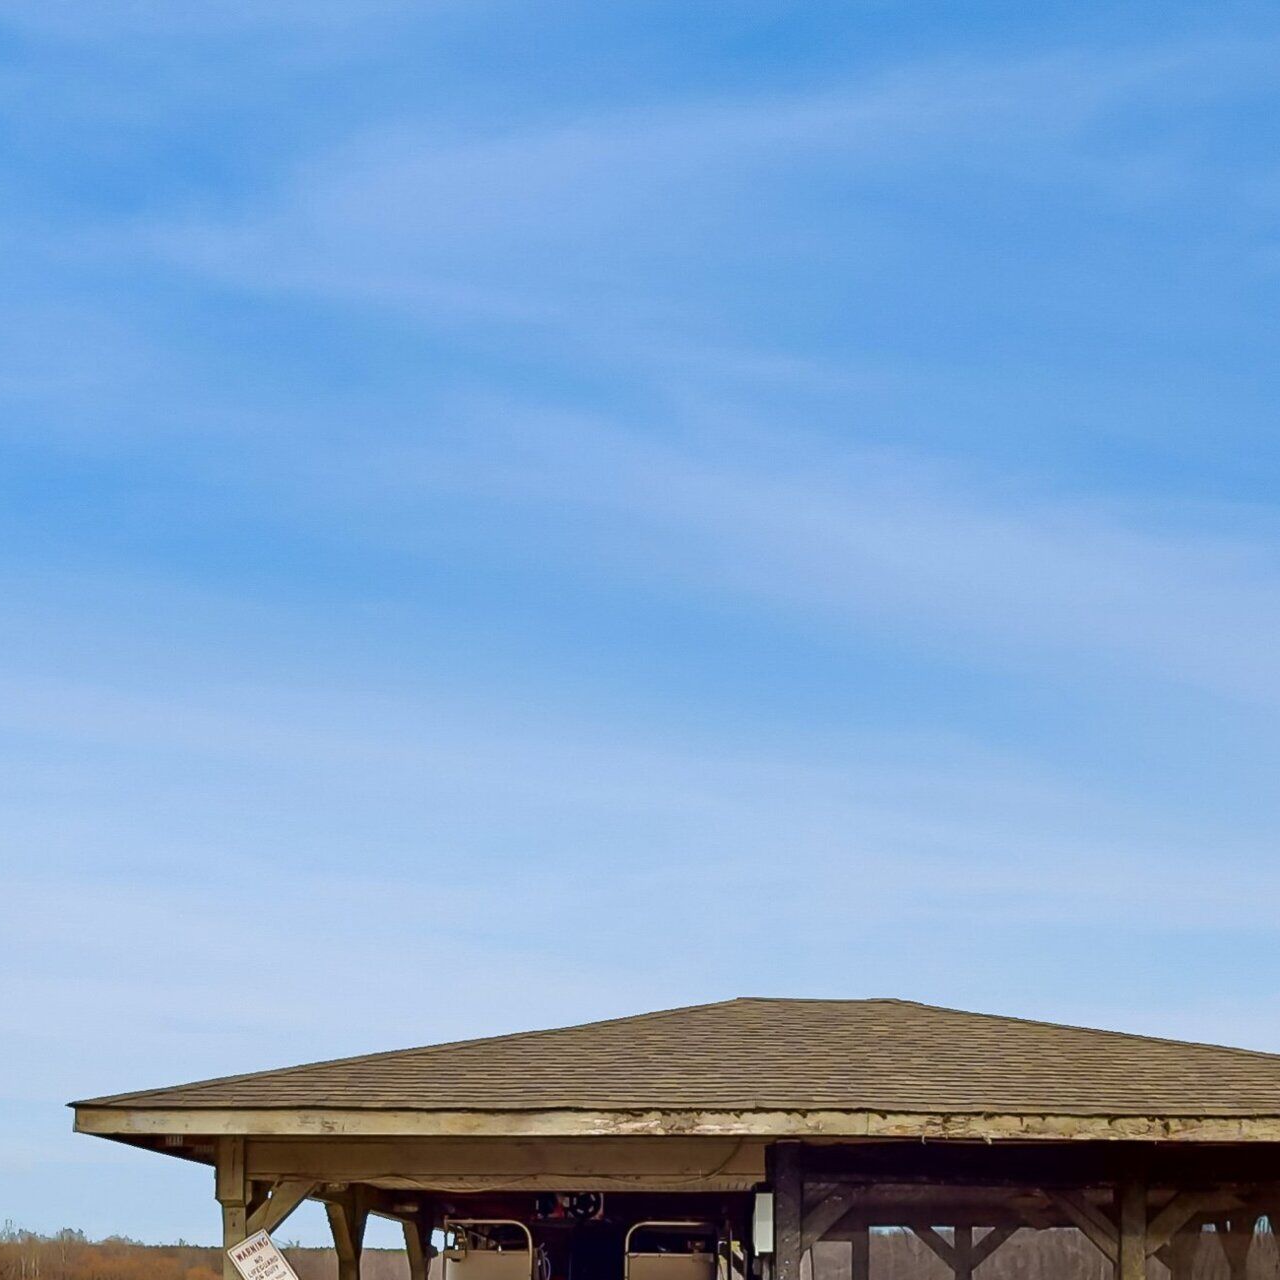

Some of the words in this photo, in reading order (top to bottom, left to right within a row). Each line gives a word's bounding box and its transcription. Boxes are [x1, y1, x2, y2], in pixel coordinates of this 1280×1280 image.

[236, 1238, 269, 1262] WARNING
[248, 1255, 279, 1278] LIFEGUARD
[254, 1255, 263, 1264] NO
[264, 1265, 279, 1277] DUTY
